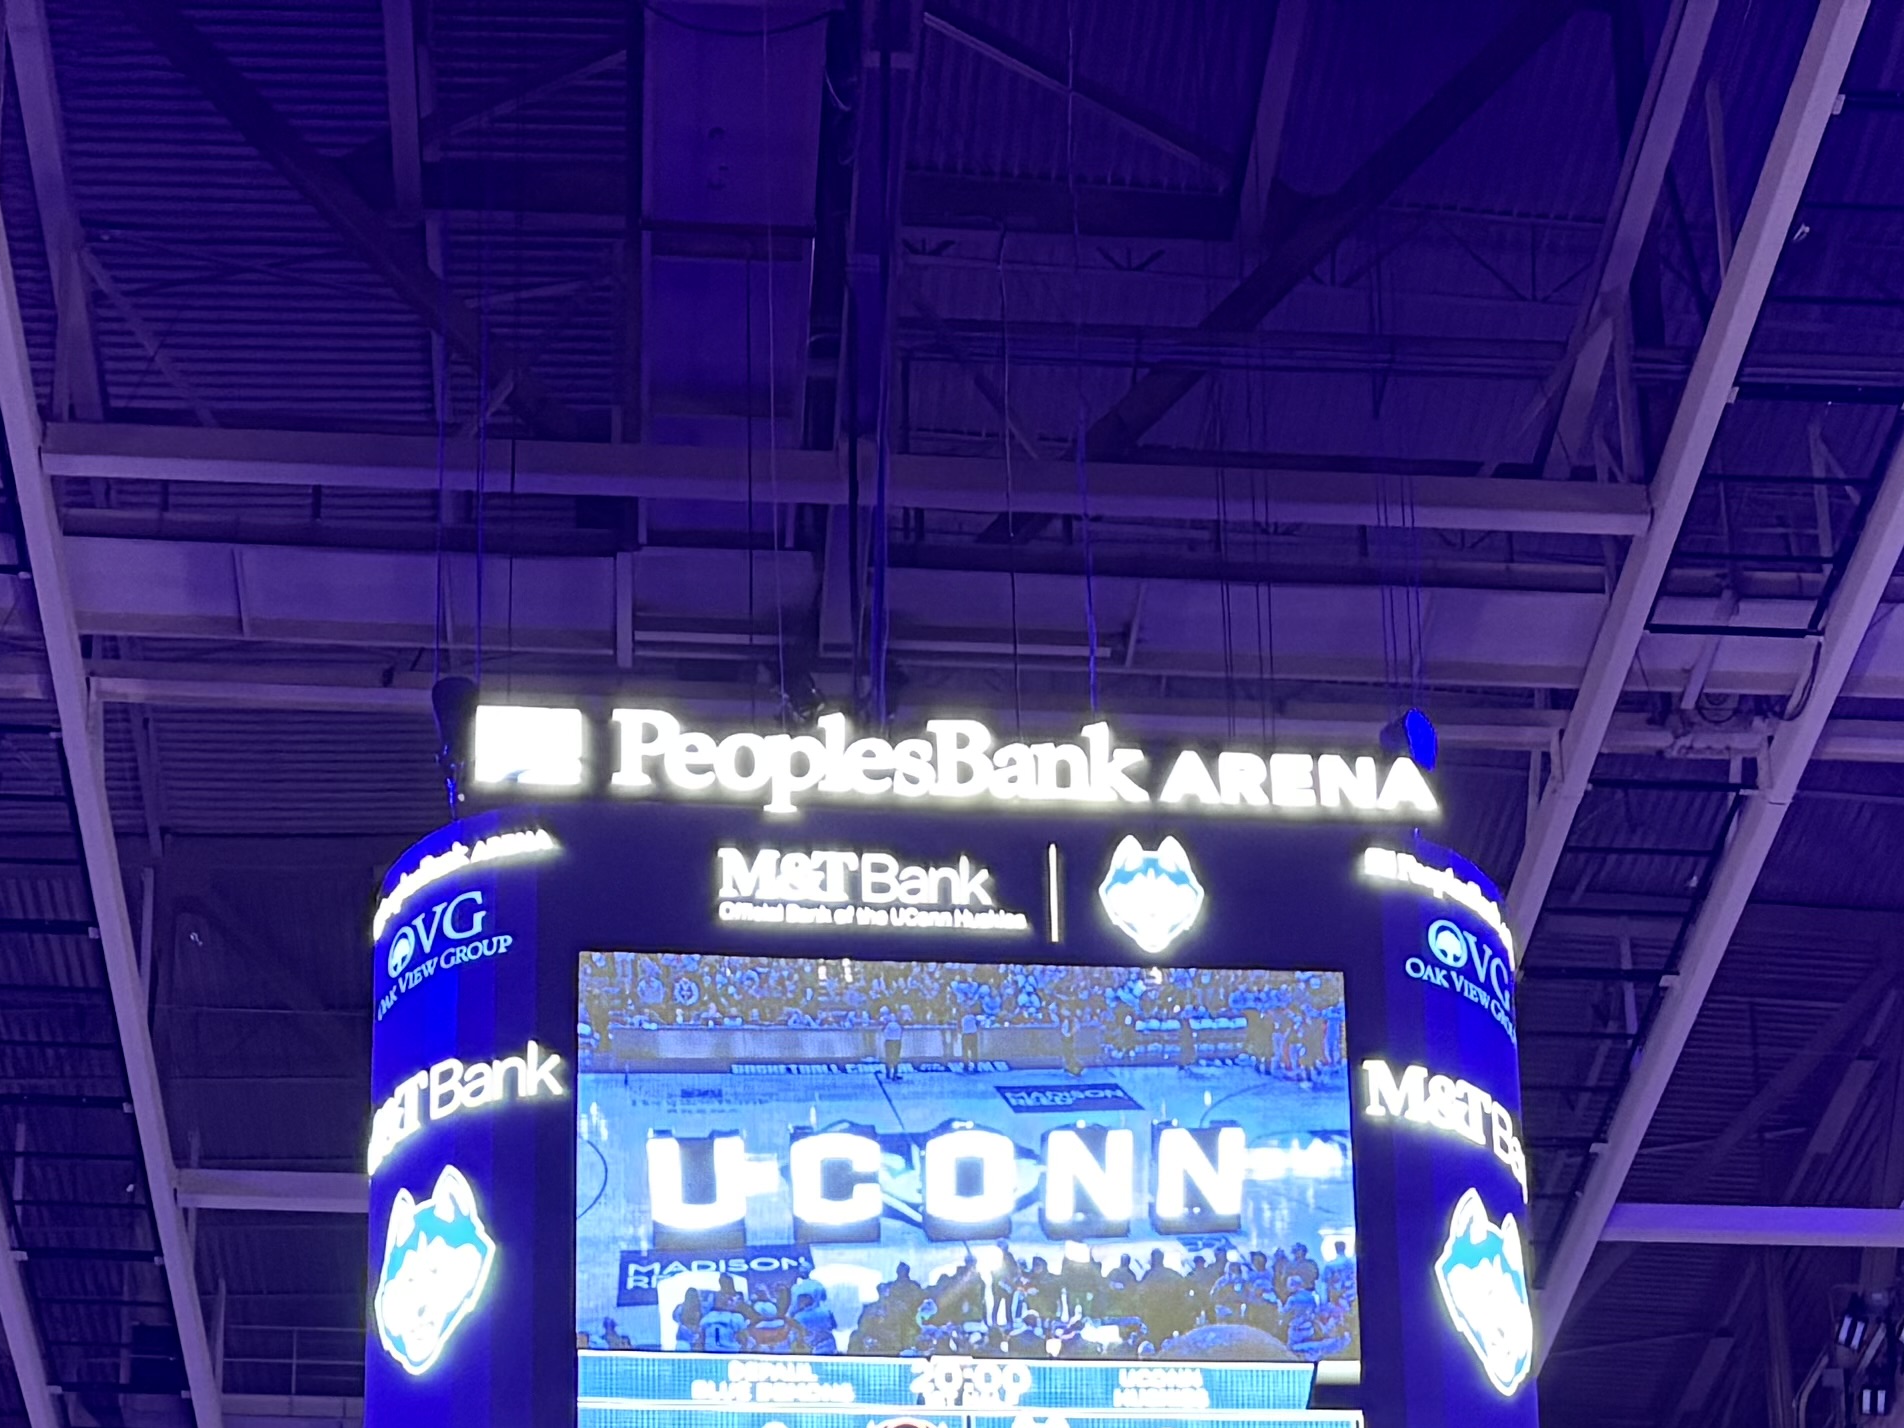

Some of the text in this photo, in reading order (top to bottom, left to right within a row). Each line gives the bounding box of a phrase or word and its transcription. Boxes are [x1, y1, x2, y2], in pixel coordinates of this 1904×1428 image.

[609, 707, 1437, 813] PeoplesBank ARENA
[717, 847, 993, 905] M&T Bank
[785, 904, 832, 924] Bank
[439, 935, 513, 969] GROUP
[1405, 957, 1450, 988] OAK
[429, 1040, 564, 1120] Bank
[1362, 1060, 1492, 1145] M&T
[646, 1128, 1245, 1231] UCONN
[626, 1255, 808, 1280] MADISON
